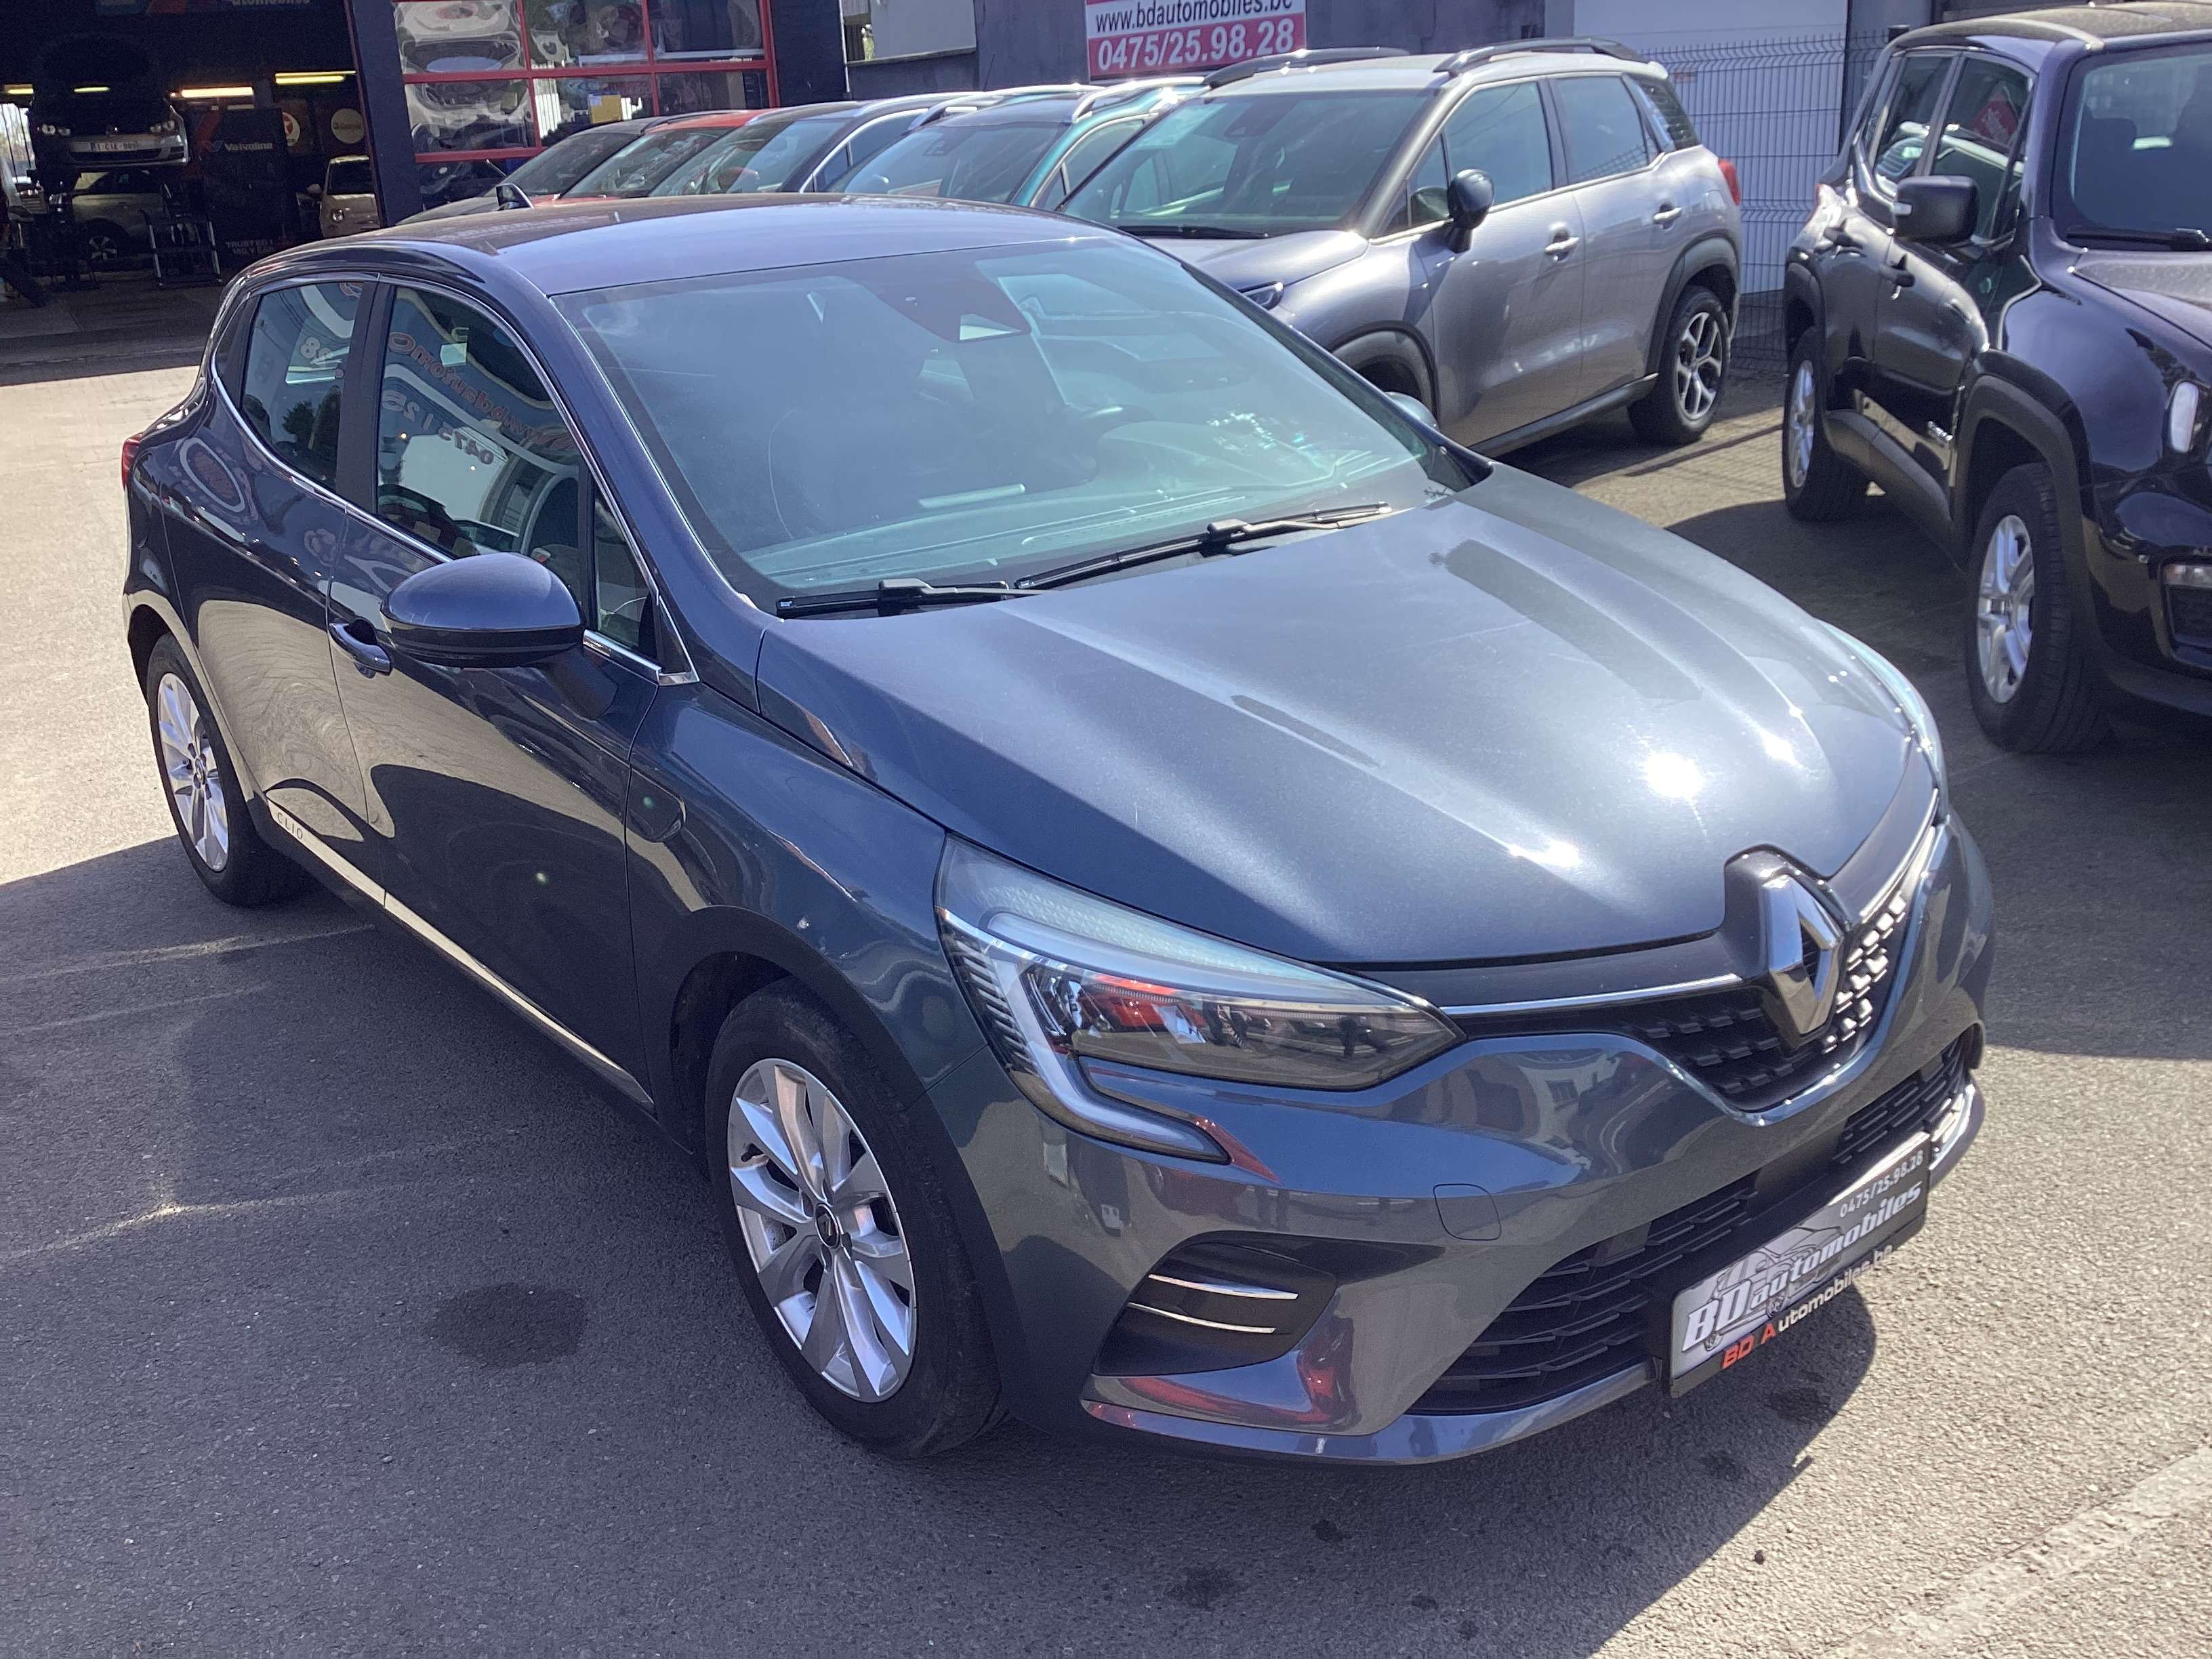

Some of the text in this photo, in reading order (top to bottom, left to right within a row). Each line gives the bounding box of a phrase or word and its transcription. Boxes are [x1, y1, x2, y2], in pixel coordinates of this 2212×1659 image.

[1096, 0, 1292, 33] www.bdautomobiles.be
[1097, 18, 1294, 70] 0475/25.98.28
[276, 811, 304, 840] CLIO
[1839, 1149, 1924, 1218] 0475/25.98.28
[1681, 1181, 1923, 1353] BDautomobiles
[1722, 1334, 1755, 1369] BD
